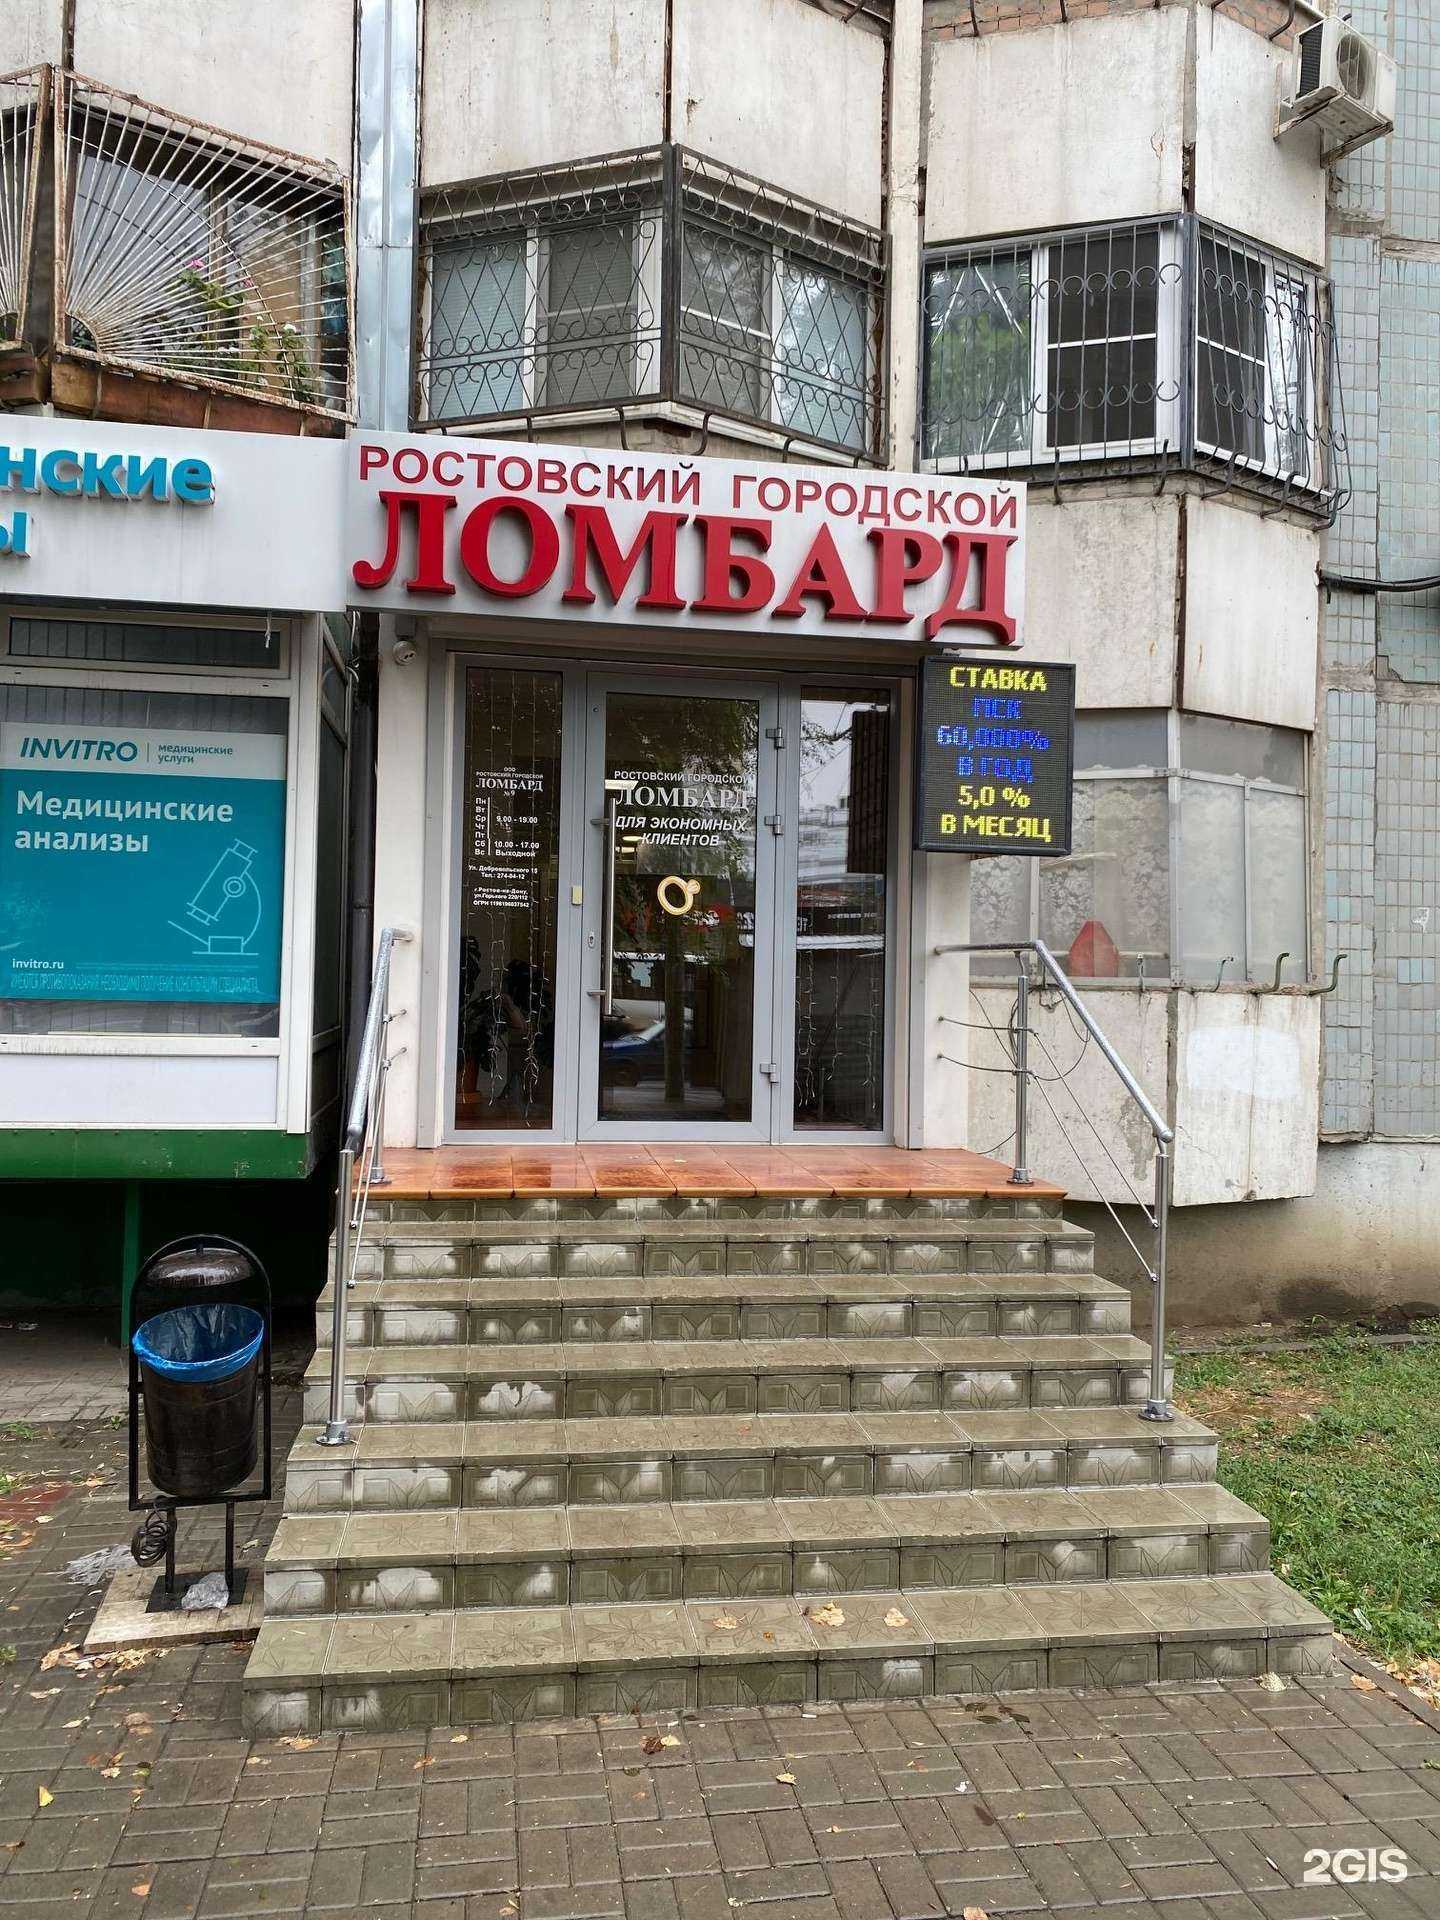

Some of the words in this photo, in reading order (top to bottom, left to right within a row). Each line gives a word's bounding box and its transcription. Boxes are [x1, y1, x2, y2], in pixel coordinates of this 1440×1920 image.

[359, 445, 701, 506] РОСТОВСКИЙ
[732, 474, 1018, 529] ГОРОДСКОЙ
[352, 490, 1018, 646] ЛОМБАРД
[949, 666, 1048, 692] СТАВКА
[973, 697, 1022, 720] ПСК
[936, 725, 1051, 751] 60,000%
[19, 737, 138, 763] INVITRO
[157, 743, 234, 757] медицинские
[157, 754, 195, 766] услуги
[957, 755, 974, 777] В
[980, 756, 1034, 784] ГОД
[475, 777, 544, 793] ЛОМБАРД
[688, 773, 754, 785] ГОРОДСКО
[475, 797, 487, 805] Пн
[615, 785, 752, 814] ЛОМБАРД
[958, 785, 996, 810] 5,0
[1001, 787, 1032, 809] %
[16, 789, 235, 823] Медицинские
[475, 805, 486, 813] Вт
[475, 814, 487, 824] Ср
[475, 822, 486, 830] Чт
[615, 815, 647, 831] ДЛЯ
[650, 817, 748, 832] ЭКОНОМНЫХ
[474, 831, 486, 839] Пт
[940, 813, 957, 834] В
[962, 813, 1053, 843] МЕСЯЦ
[14, 829, 149, 853] анализы
[474, 839, 486, 847] Сб
[494, 840, 514, 848] 10.00
[520, 841, 540, 849] 17.00
[640, 833, 721, 847] КЛИЕНТОВ
[474, 848, 486, 856] Вс
[495, 849, 536, 858] Выходной
[11, 958, 65, 970] invitro.ru
